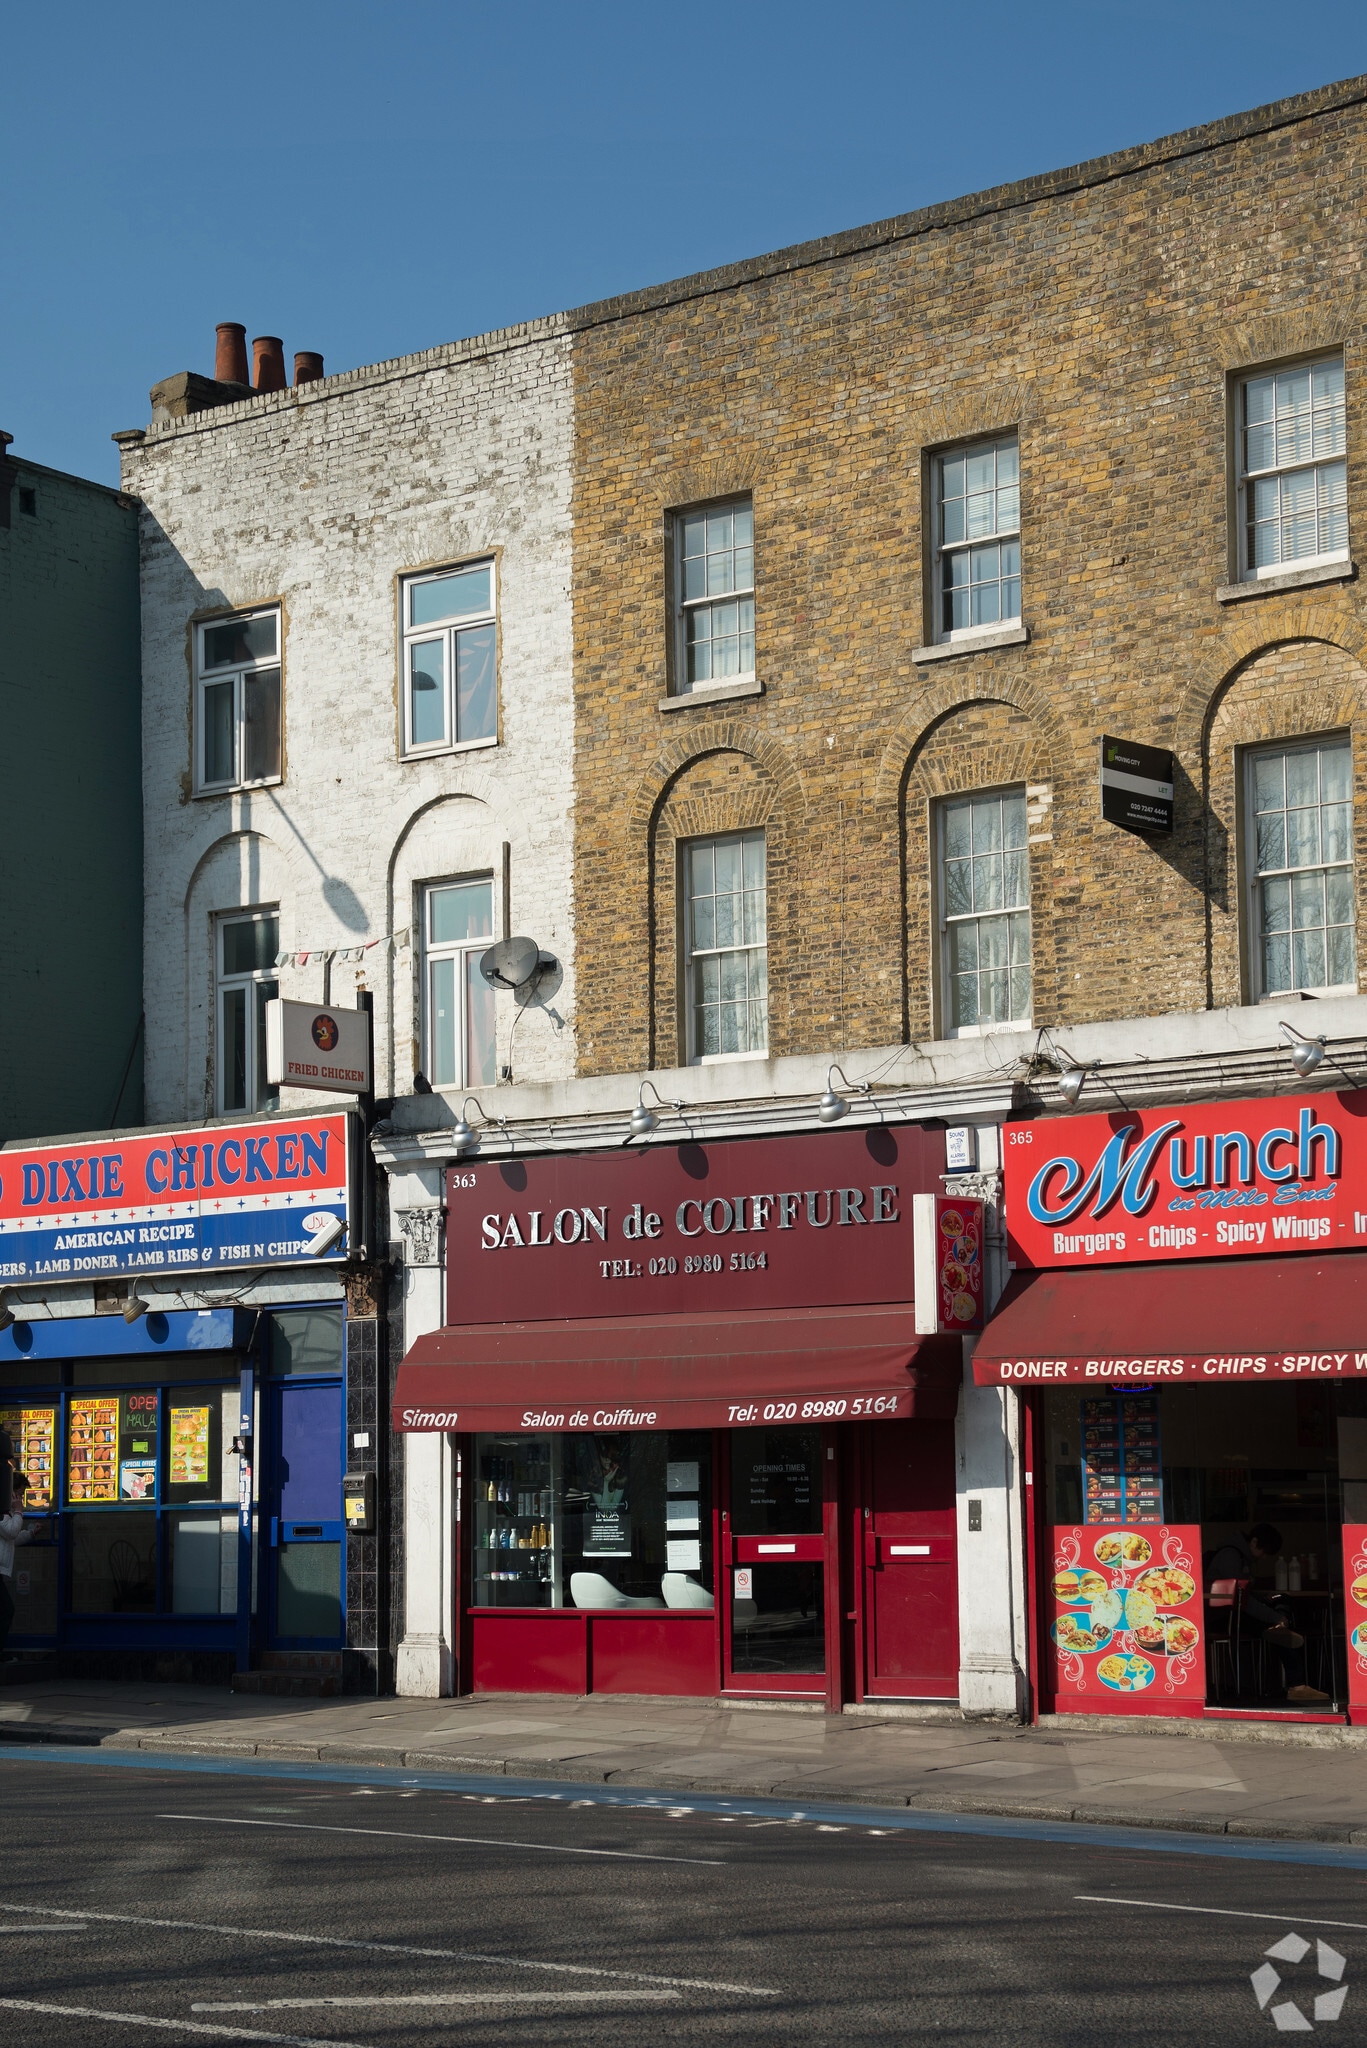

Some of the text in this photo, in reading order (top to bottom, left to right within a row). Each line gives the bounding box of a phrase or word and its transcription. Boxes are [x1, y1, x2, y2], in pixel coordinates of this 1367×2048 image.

[1130, 803, 1141, 811] 020
[288, 1062, 364, 1082] FRIED CHICKEN
[1009, 1131, 1033, 1145] 365
[21, 1154, 125, 1206] DIXIE
[145, 1130, 330, 1195] CHICKEN
[1027, 1108, 1338, 1224] Munch
[453, 1174, 476, 1188] 363
[1168, 1182, 1337, 1212] in Mile End
[481, 1185, 898, 1250] SALON de COIFFURE
[54, 1224, 195, 1250] AMERICAN RECIPE
[1053, 1232, 1126, 1255] Burgers
[1148, 1225, 1197, 1249] Chips
[1216, 1220, 1266, 1246] Spicy
[1272, 1216, 1331, 1241] Wings
[0, 1262, 26, 1277] ERS
[35, 1258, 71, 1274] LAMB
[128, 1251, 164, 1266] LAMB
[167, 1248, 199, 1264] RIBS
[202, 1248, 213, 1261] &
[219, 1245, 251, 1260] FISH
[254, 1244, 264, 1257] N
[599, 1251, 767, 1278] TEL: 020 8980 5164
[1001, 1361, 1067, 1378] DONER
[1085, 1359, 1184, 1377] BURGERS
[1203, 1357, 1267, 1374] CHIPS
[1282, 1354, 1348, 1373] SPICY
[8, 1410, 52, 1419] SPECIAL OFFERS
[76, 1401, 96, 1409] SPECIAL
[728, 1396, 898, 1421] Tel: 020 8980 5164
[402, 1409, 458, 1427] Simon
[520, 1409, 657, 1427] Salon de Coiffure
[752, 1463, 806, 1472] OPENING TIMES
